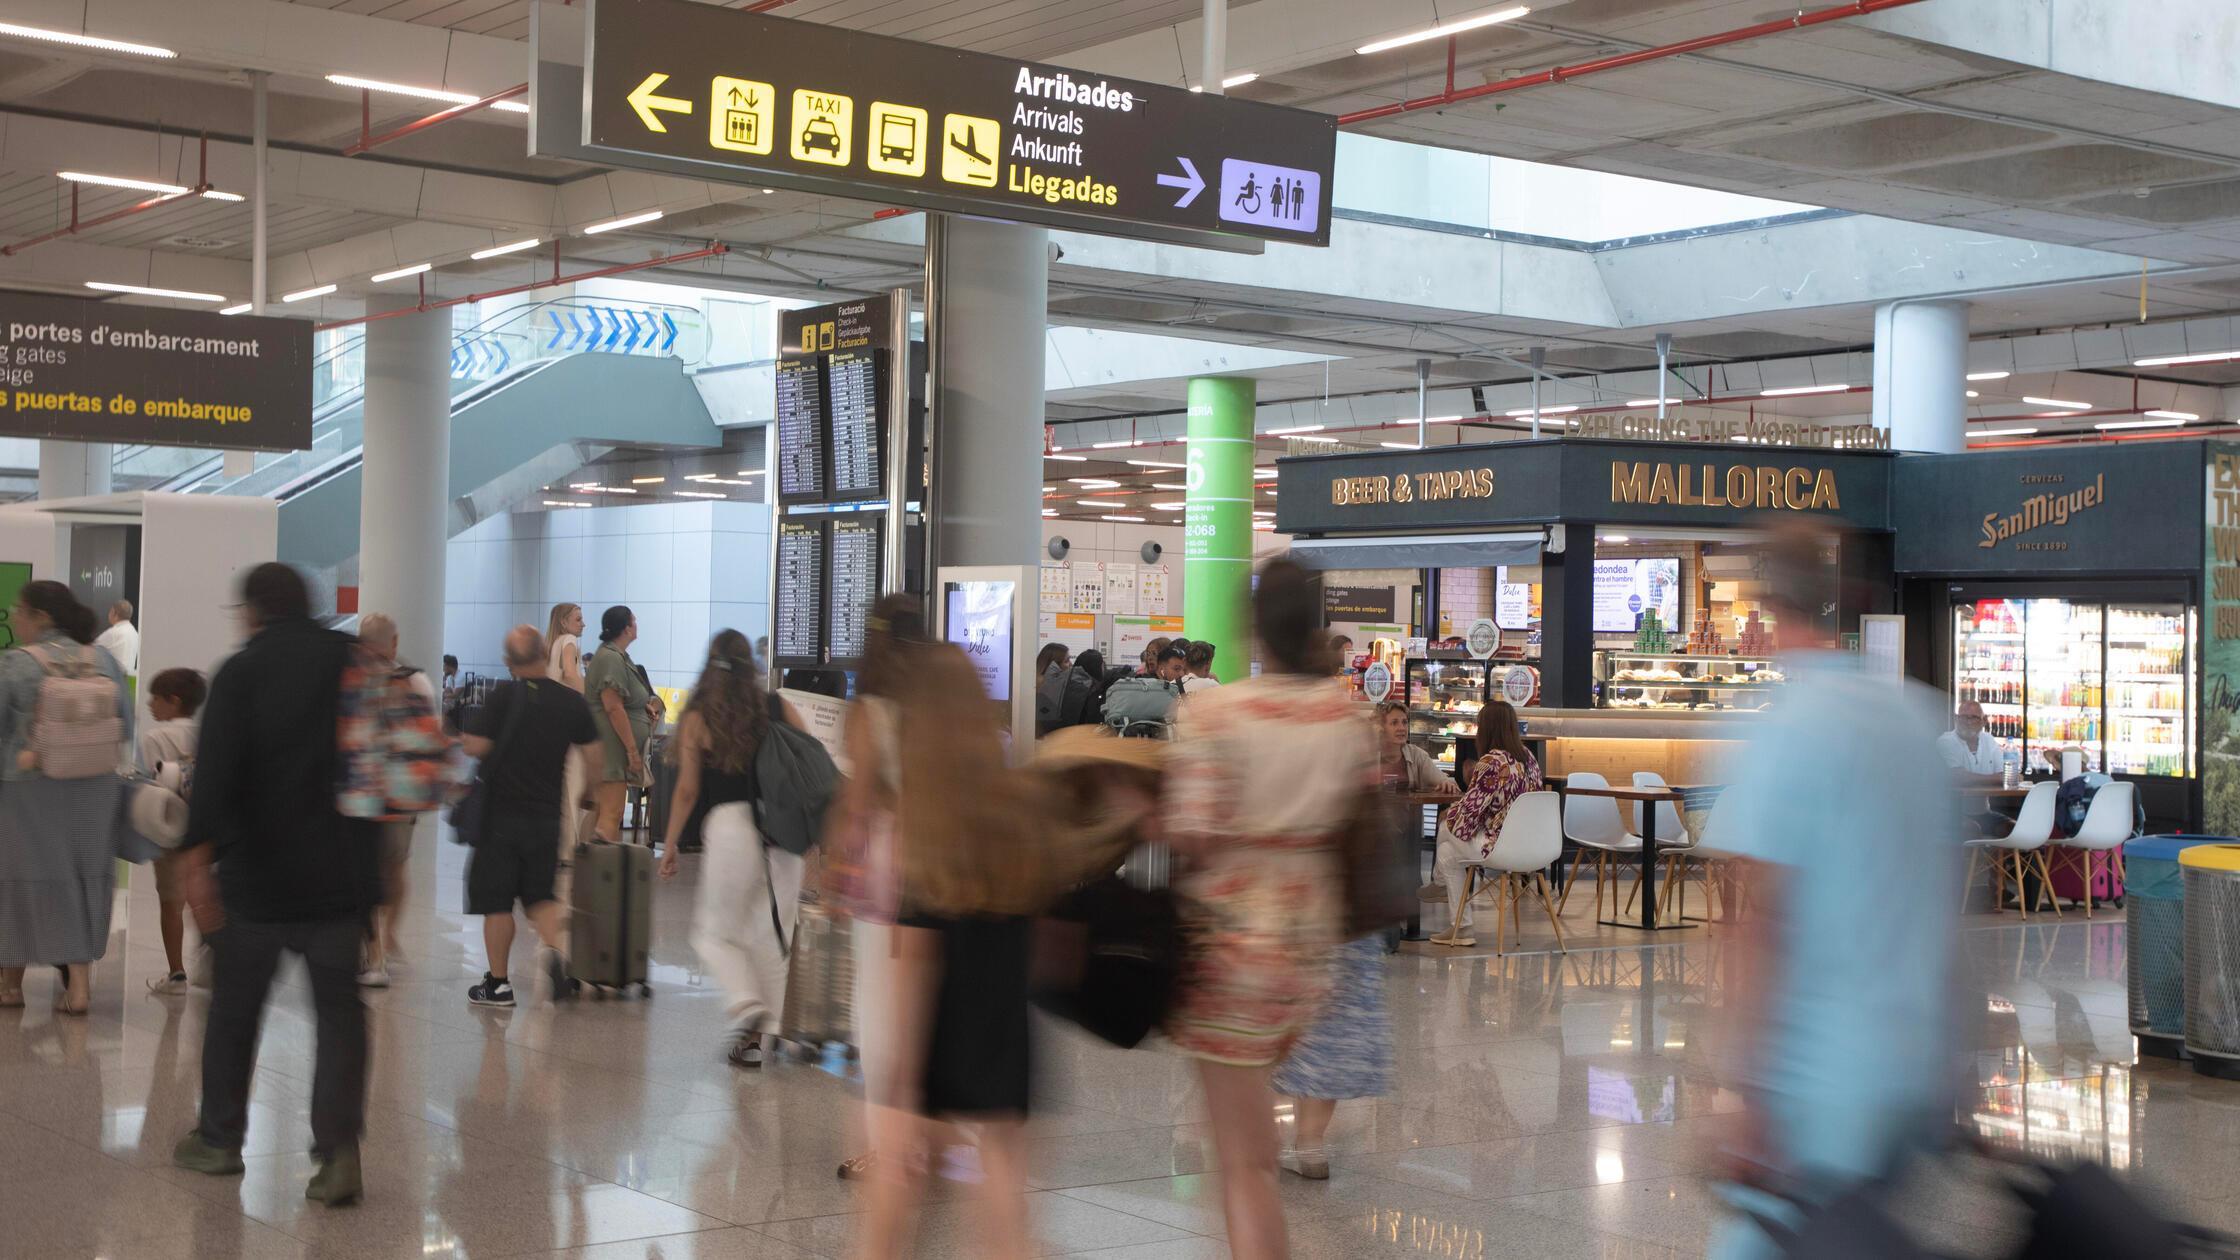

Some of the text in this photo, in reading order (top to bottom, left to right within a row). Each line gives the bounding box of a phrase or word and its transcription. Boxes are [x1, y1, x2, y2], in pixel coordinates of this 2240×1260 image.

[805, 95, 841, 115] TAXI
[1014, 67, 1134, 112] Arribades
[1012, 102, 1084, 135] Arrivals
[1011, 133, 1083, 167] Ankunft
[1009, 164, 1118, 206] Llegadas
[10, 323, 82, 343] portes
[15, 346, 66, 366] gates
[15, 391, 102, 412] puertas
[109, 394, 137, 415] de
[144, 397, 252, 425] embarque
[1563, 413, 1892, 450] EXPLORING THE WORLD FROM
[1331, 468, 1494, 505] BEER & TAPAS
[1611, 461, 1840, 510] MALLORCA
[2020, 474, 2065, 484] CERVEZAS
[2016, 542, 2068, 551] SINCE 1890
[95, 565, 113, 588] info
[1606, 575, 1611, 583] el
[1612, 575, 1634, 583] hambre
